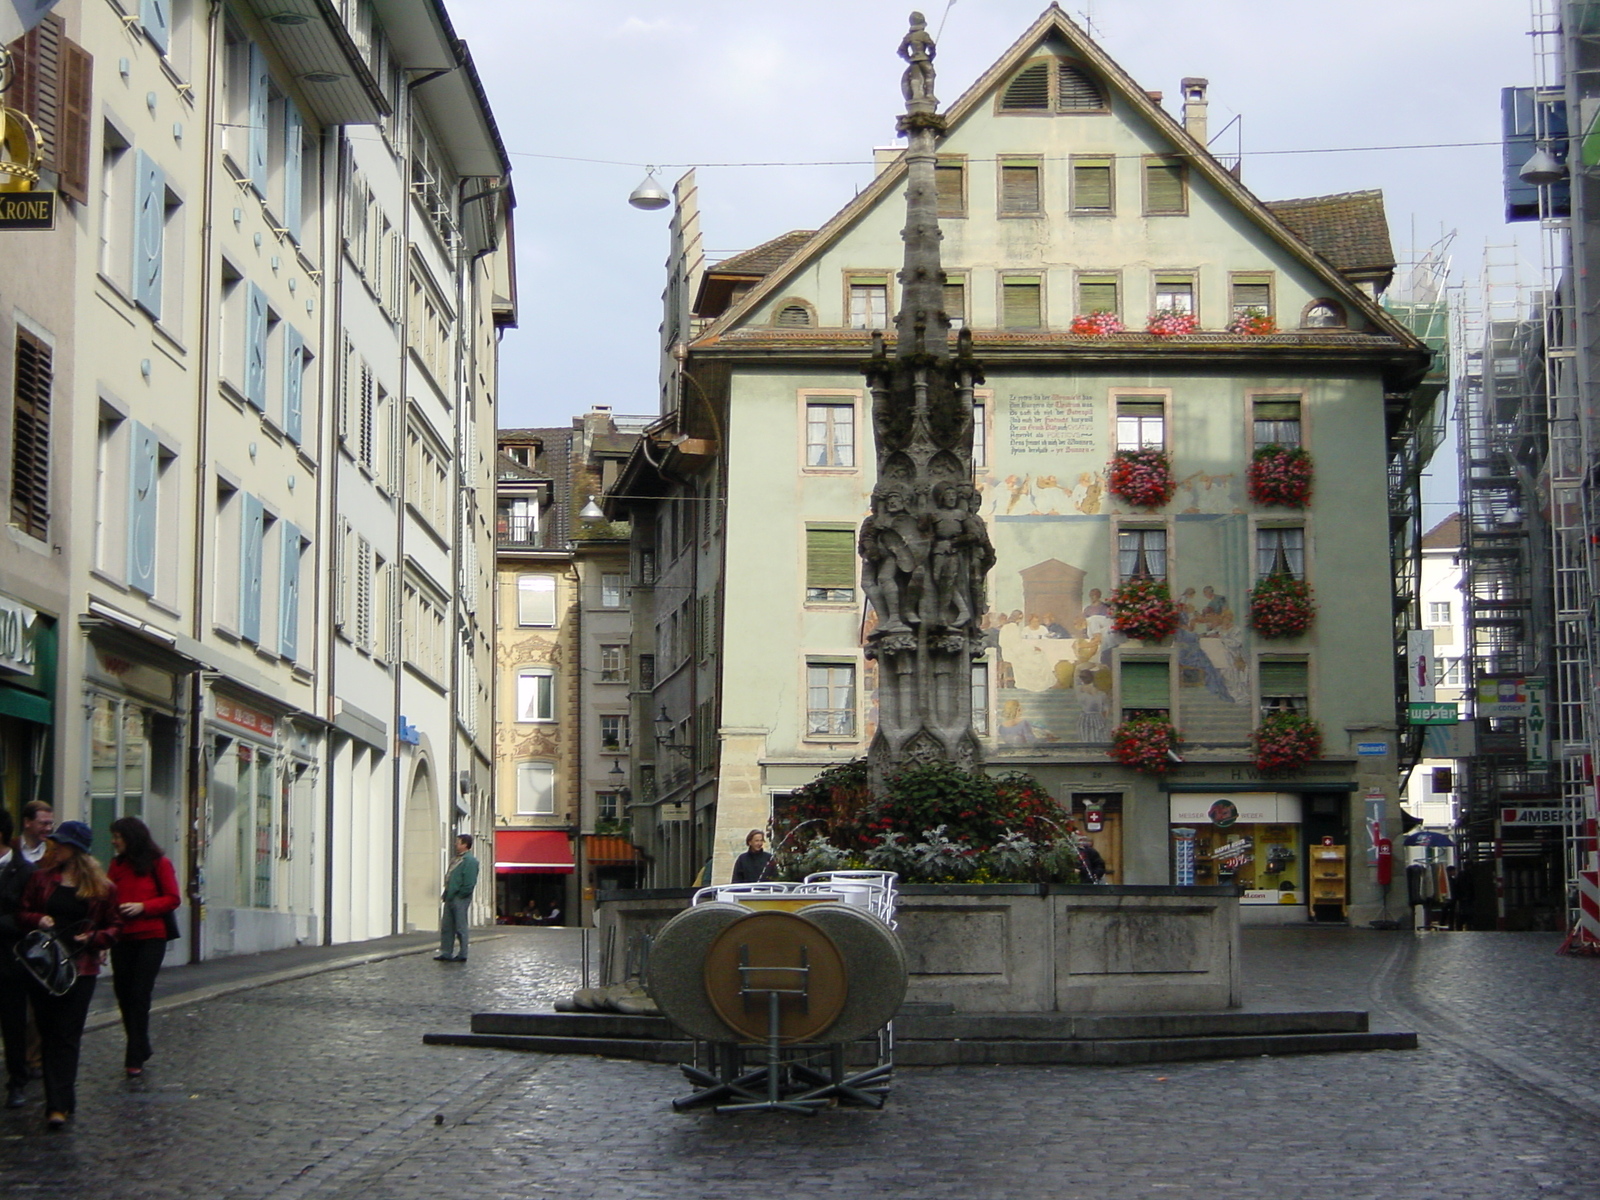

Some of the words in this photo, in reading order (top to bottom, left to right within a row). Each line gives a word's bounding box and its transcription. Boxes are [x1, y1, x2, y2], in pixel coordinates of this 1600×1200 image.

[0, 197, 49, 220] KRONE
[1411, 705, 1456, 719] weber
[1528, 691, 1545, 760] LAWIL
